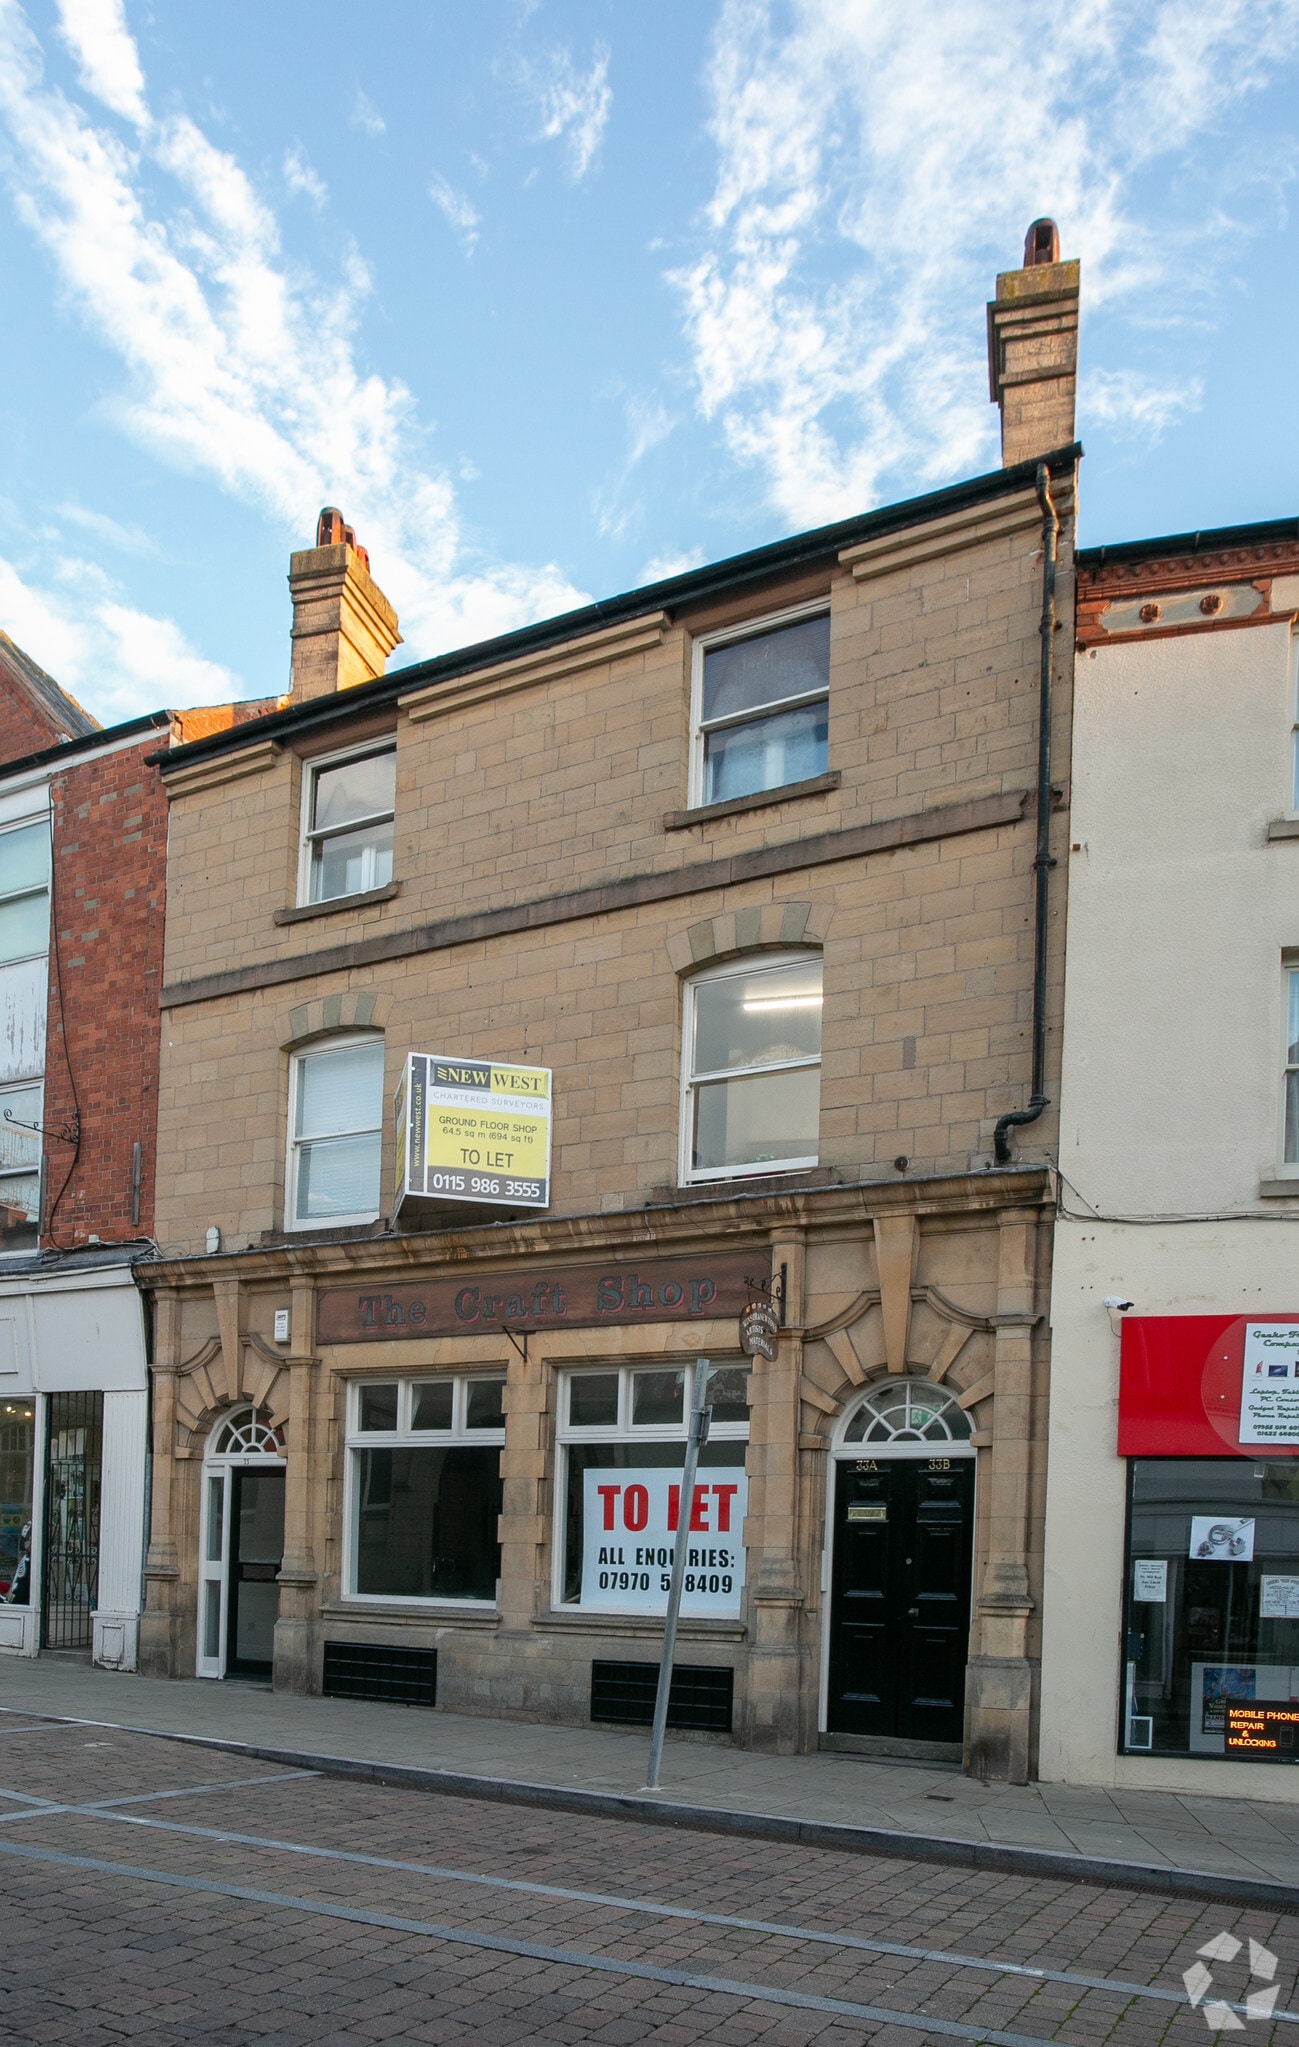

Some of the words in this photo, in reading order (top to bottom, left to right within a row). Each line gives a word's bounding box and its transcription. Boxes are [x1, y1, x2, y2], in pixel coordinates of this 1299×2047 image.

[447, 1067, 489, 1086] NEW
[493, 1073, 542, 1091] WEST
[433, 1091, 488, 1105] CHARTERED
[491, 1097, 544, 1111] SURVEYORS
[413, 1083, 422, 1167] www.newwest.co.uk
[438, 1115, 477, 1128] GROUND
[480, 1120, 509, 1131] FLOOR
[512, 1123, 538, 1134] SHOP
[442, 1126, 461, 1136] 64.5
[464, 1129, 476, 1139] sq
[477, 1131, 486, 1139] m
[489, 1131, 508, 1141] (694
[510, 1134, 521, 1144] sq
[523, 1135, 534, 1145] ft)
[460, 1148, 480, 1165] TO
[486, 1151, 514, 1169] LET
[433, 1173, 465, 1191] 0115
[471, 1177, 500, 1195] 986
[505, 1181, 540, 1198] 3555
[358, 1295, 428, 1329] The
[454, 1281, 568, 1324] Craft
[597, 1273, 719, 1316] Shop
[856, 1459, 878, 1471] 33A
[928, 1458, 951, 1470] 33B
[597, 1483, 649, 1532] TO
[598, 1547, 625, 1565] ALL
[635, 1547, 735, 1568] ENQRIES:
[599, 1571, 650, 1591] 07970
[660, 1573, 733, 1594] 58409
[1229, 1709, 1265, 1719] MOBILE
[1230, 1721, 1265, 1730] REPAIR
[1242, 1730, 1250, 1738] &
[1228, 1737, 1277, 1748] UNLOCKING
